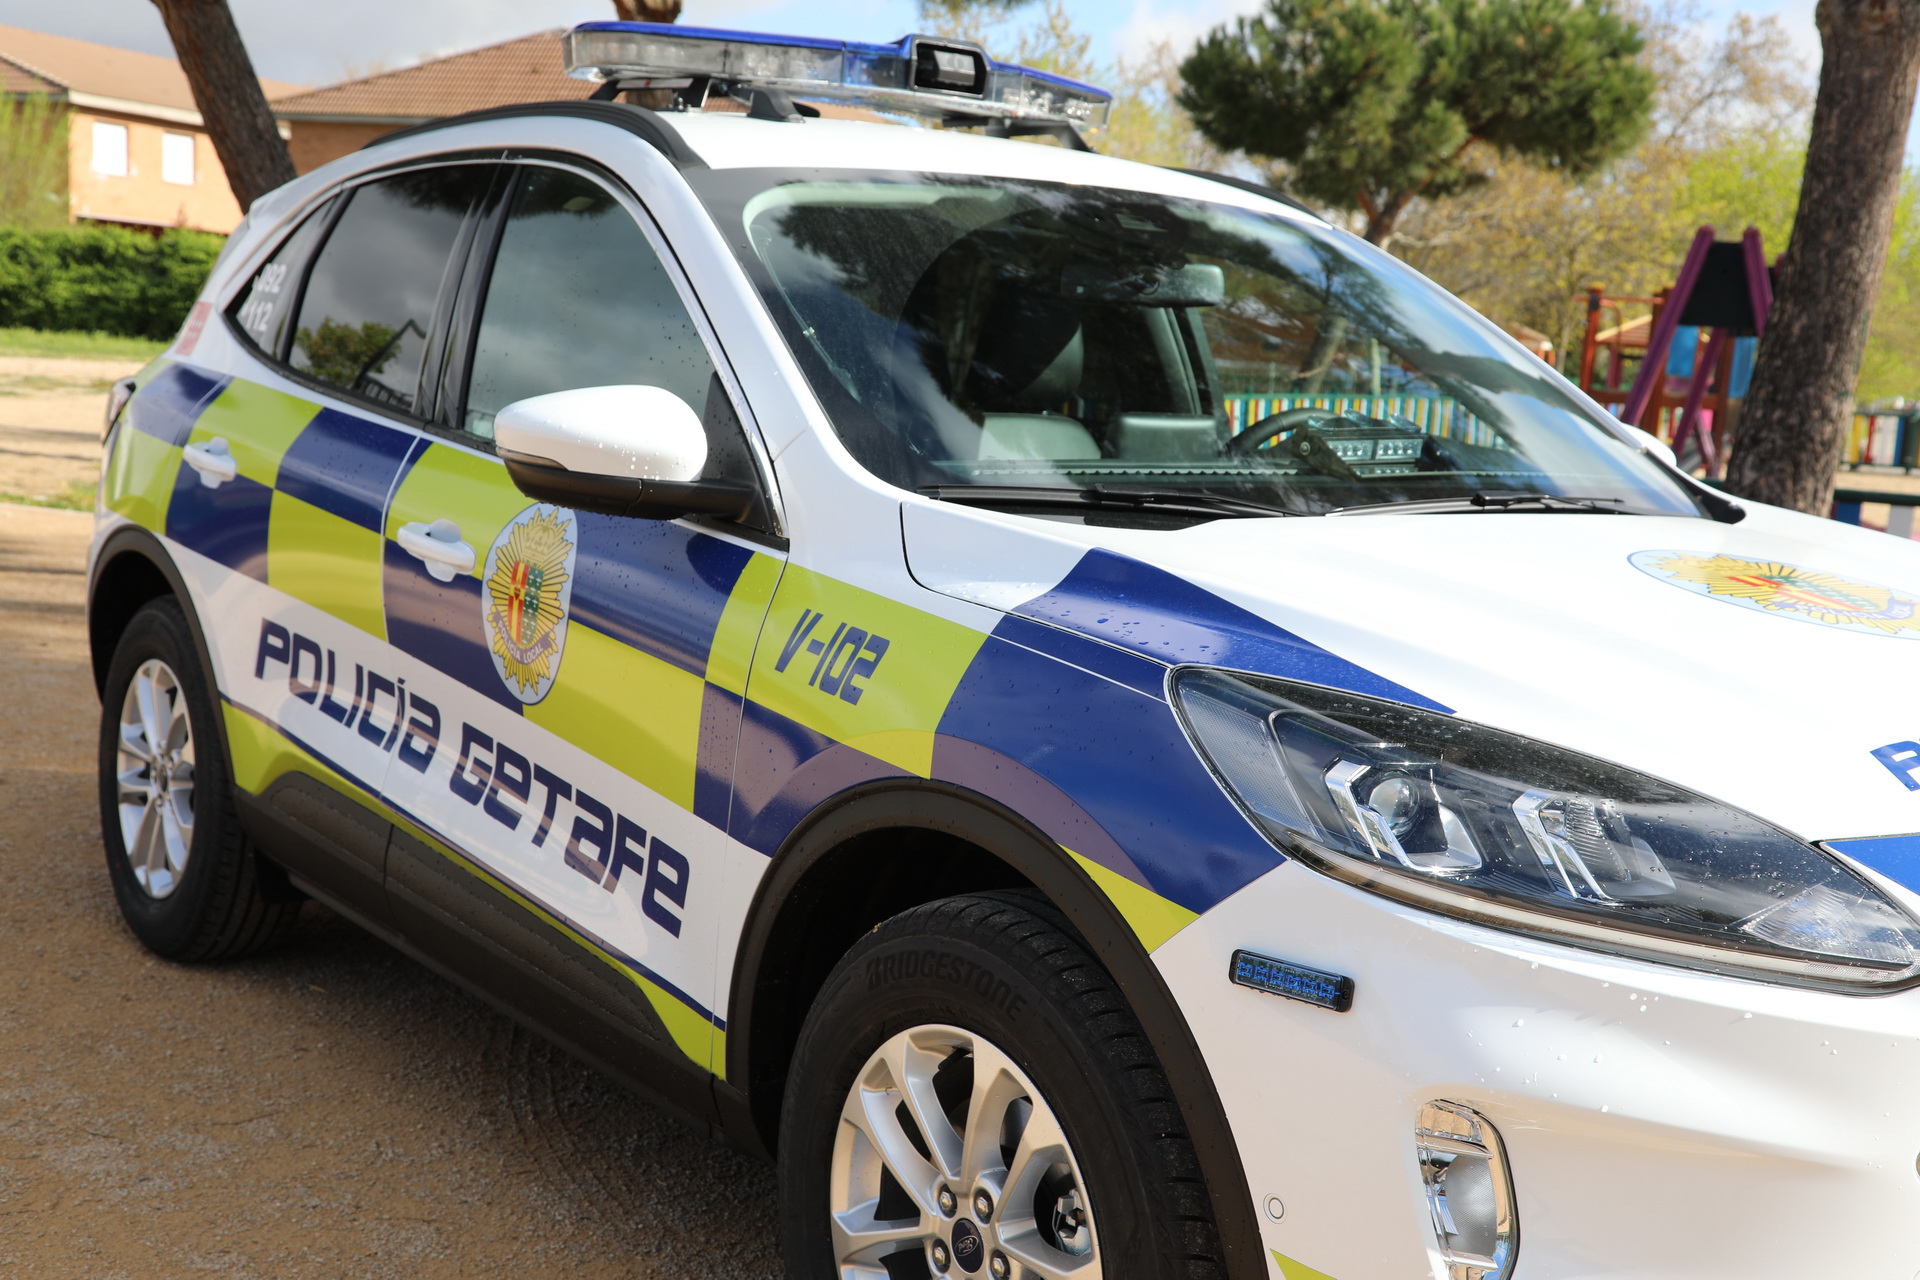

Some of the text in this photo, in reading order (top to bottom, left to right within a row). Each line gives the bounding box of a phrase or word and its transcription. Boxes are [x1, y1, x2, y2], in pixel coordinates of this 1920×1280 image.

[245, 300, 273, 331] 112
[523, 642, 544, 664] LOCAL
[774, 608, 891, 706] V-102
[865, 950, 1028, 1023] BRIDGESTONE
